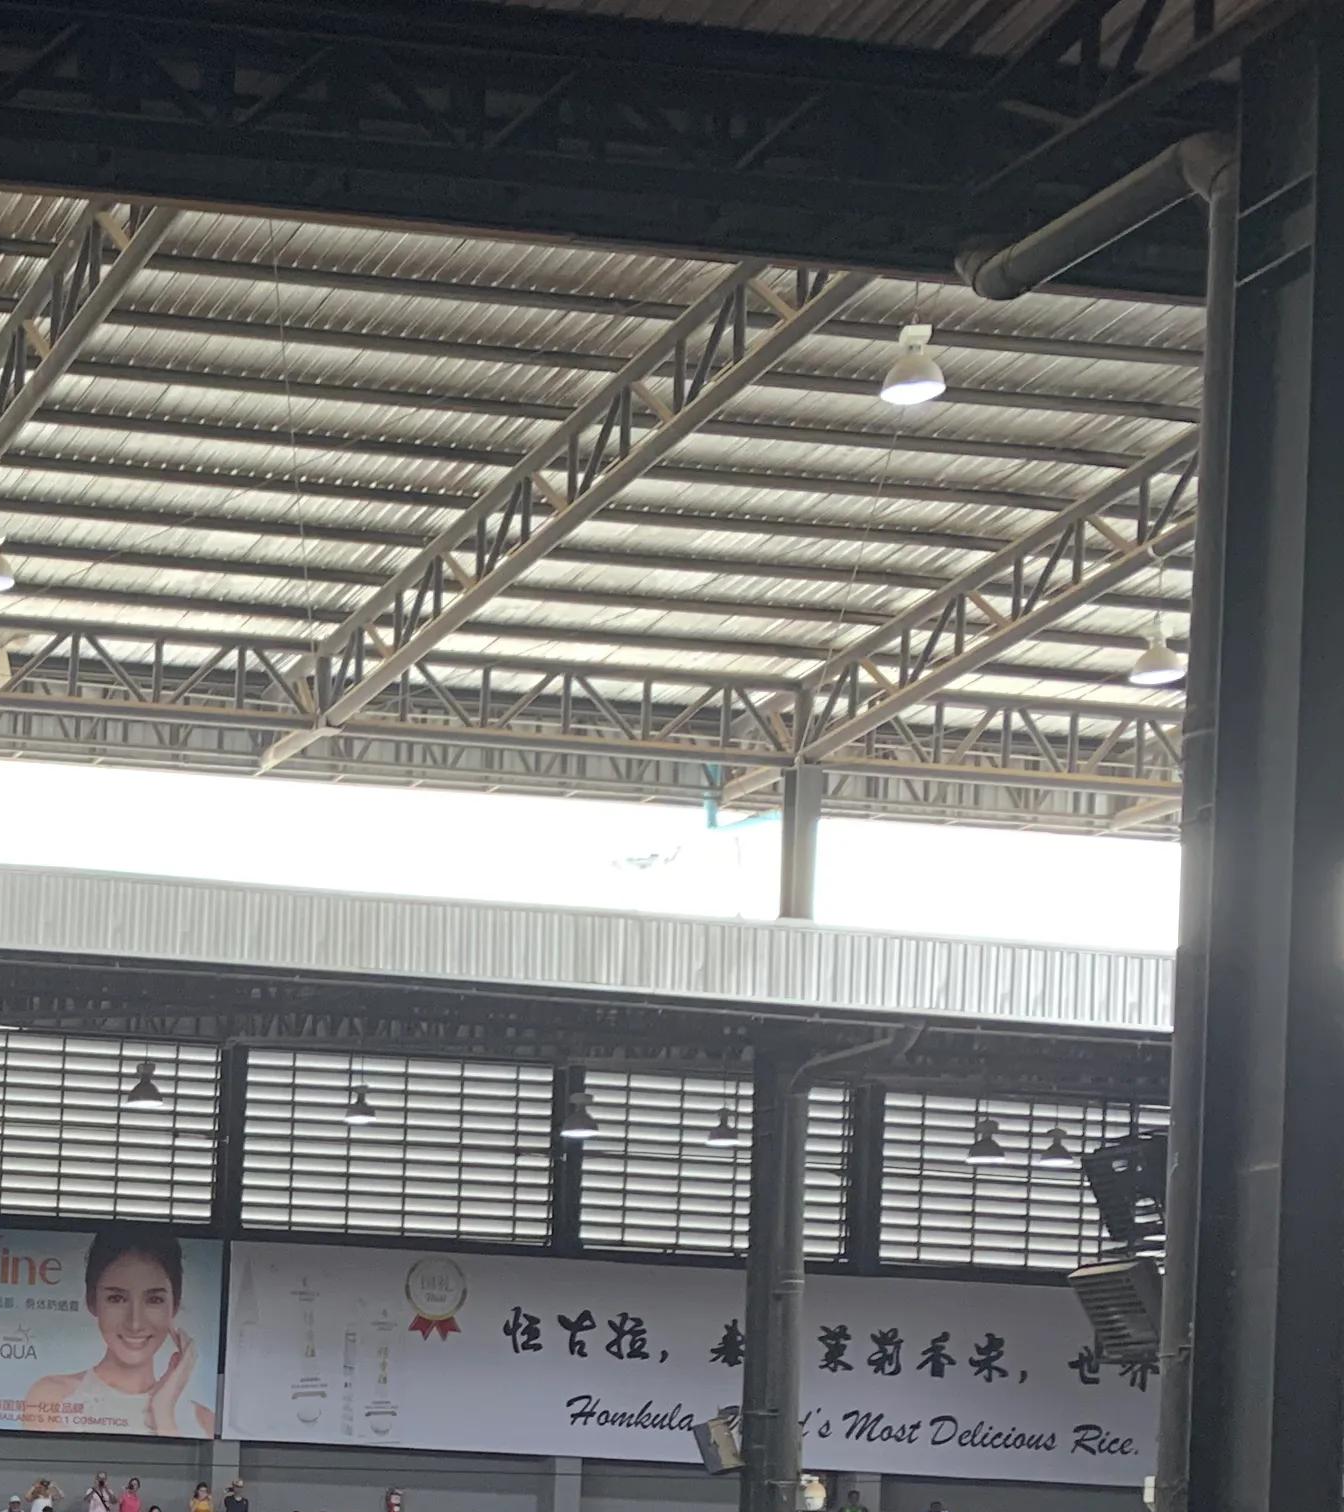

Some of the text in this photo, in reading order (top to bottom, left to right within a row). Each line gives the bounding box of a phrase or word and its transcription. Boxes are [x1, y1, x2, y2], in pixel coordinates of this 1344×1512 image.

[565, 1394, 696, 1432] Homkula
[841, 1409, 923, 1445] Most
[929, 1415, 1058, 1452] Delicious
[1069, 1424, 1140, 1457] Rice.
